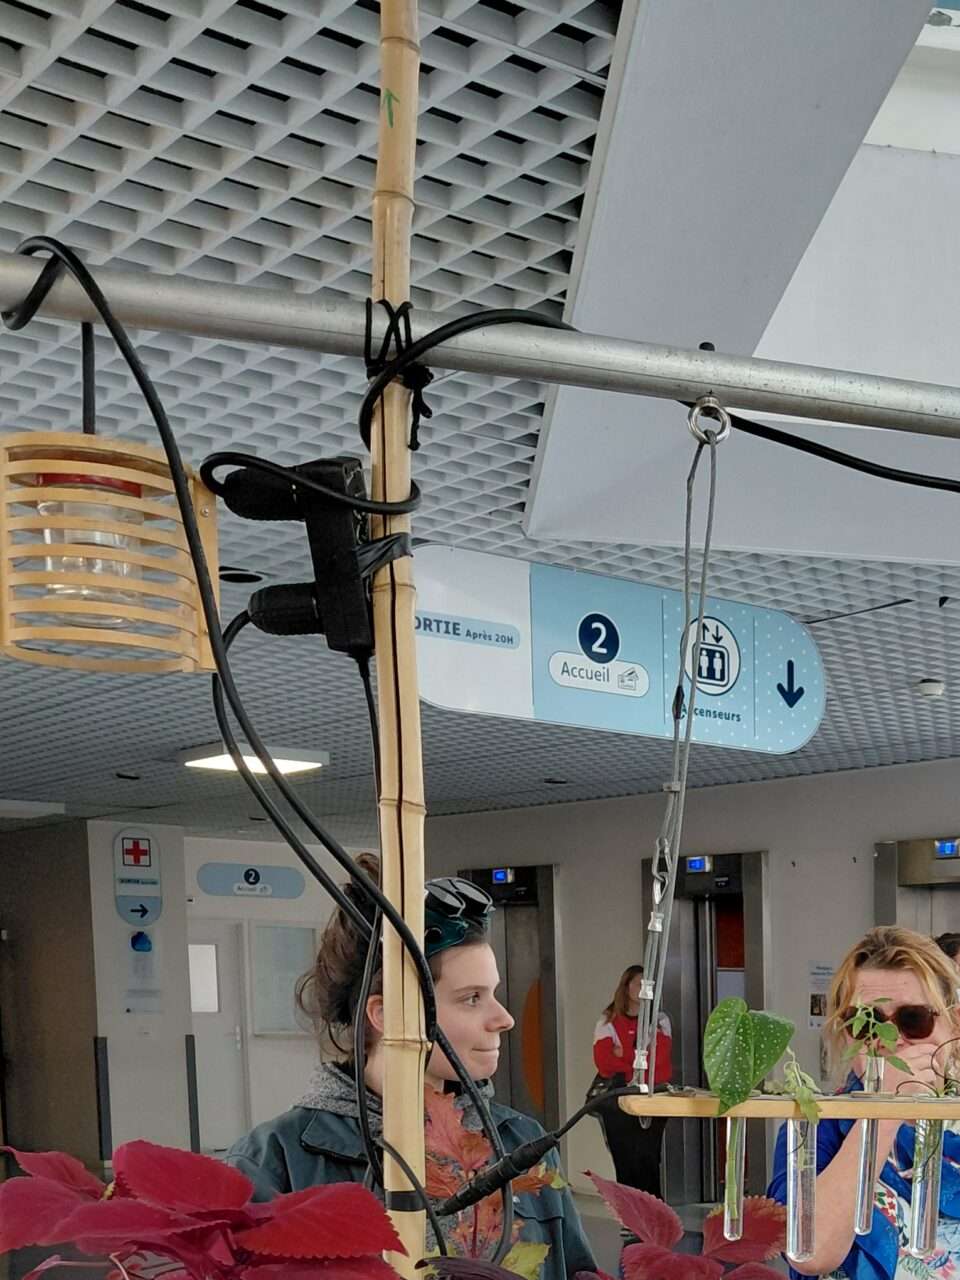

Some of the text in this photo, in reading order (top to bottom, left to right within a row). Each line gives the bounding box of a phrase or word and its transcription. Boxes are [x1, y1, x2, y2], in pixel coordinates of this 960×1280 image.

[414, 615, 514, 645] ORTIE Après 20H
[591, 622, 608, 654] 2
[561, 661, 611, 683] Accueil
[248, 871, 256, 882] 2
